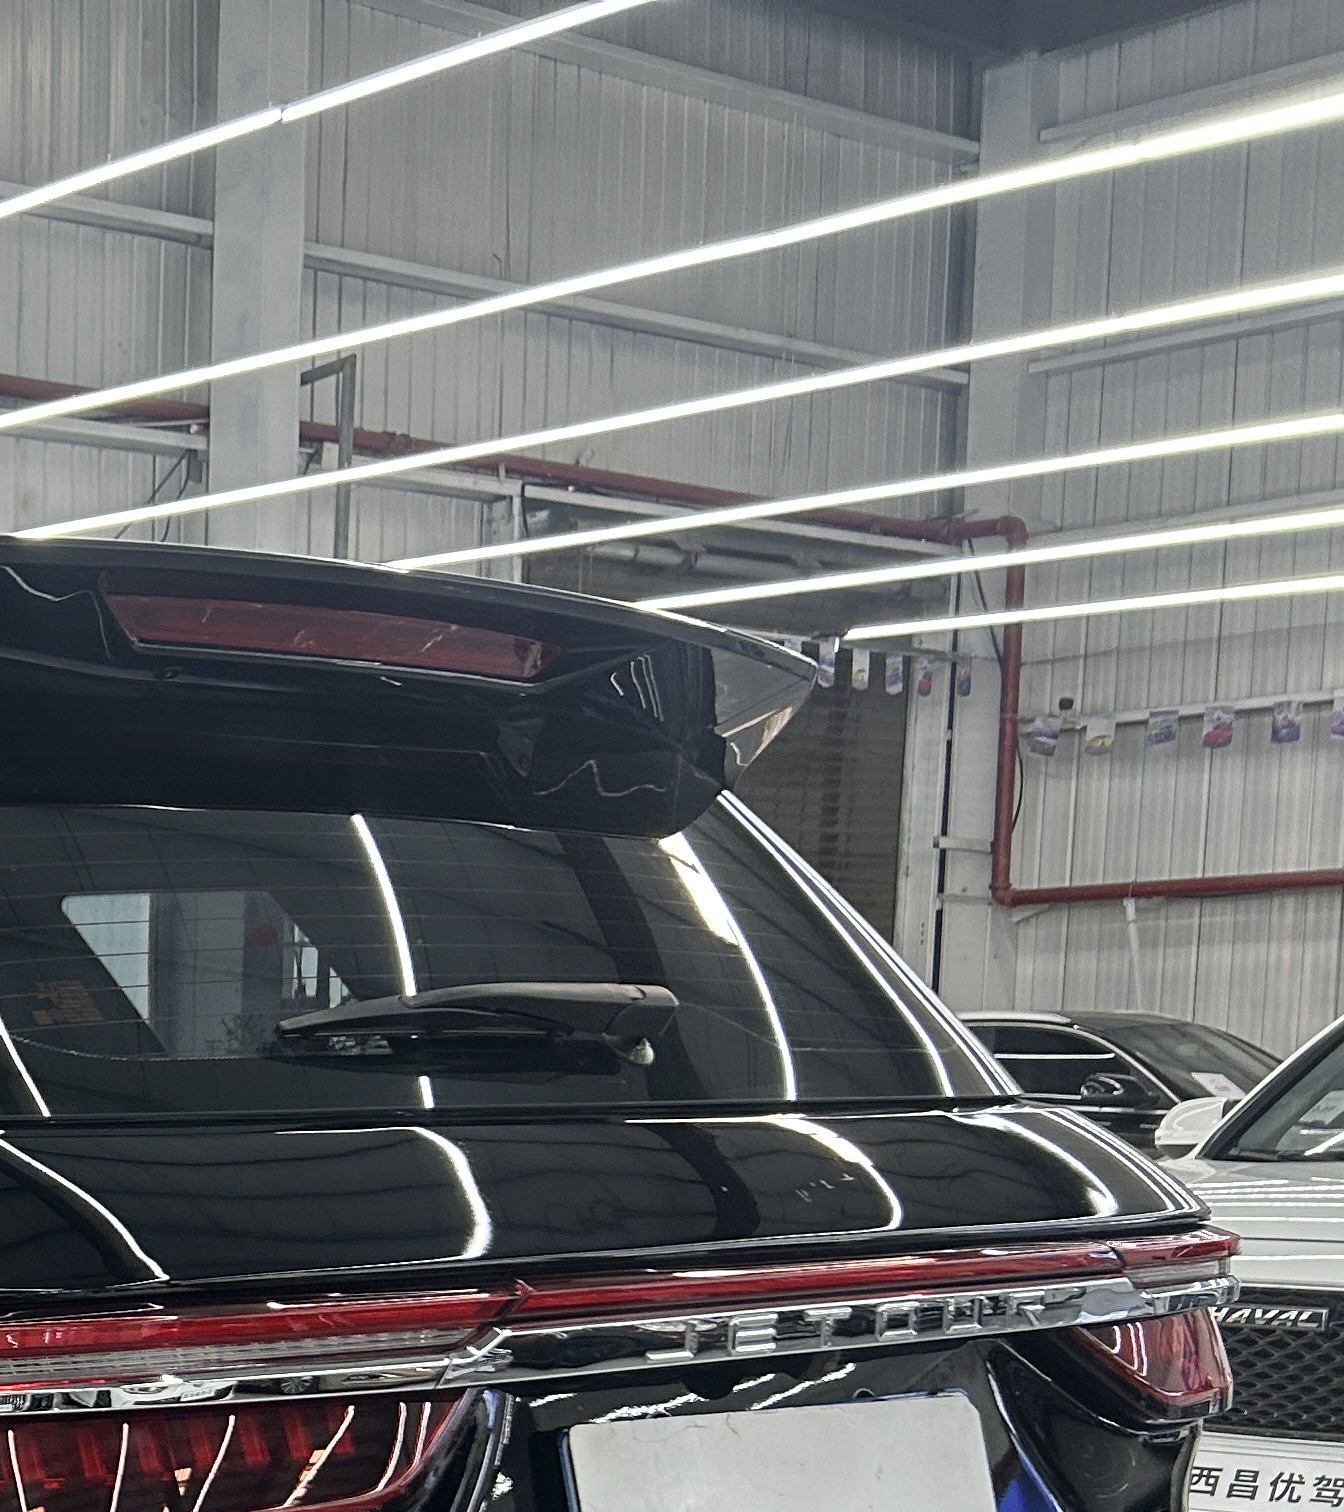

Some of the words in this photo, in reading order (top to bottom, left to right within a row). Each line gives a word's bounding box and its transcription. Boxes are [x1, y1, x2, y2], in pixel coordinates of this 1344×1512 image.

[644, 1289, 1048, 1364] JETOUR
[1207, 1306, 1319, 1328] HAVAL
[1189, 1465, 1344, 1507] 西昌优驾
